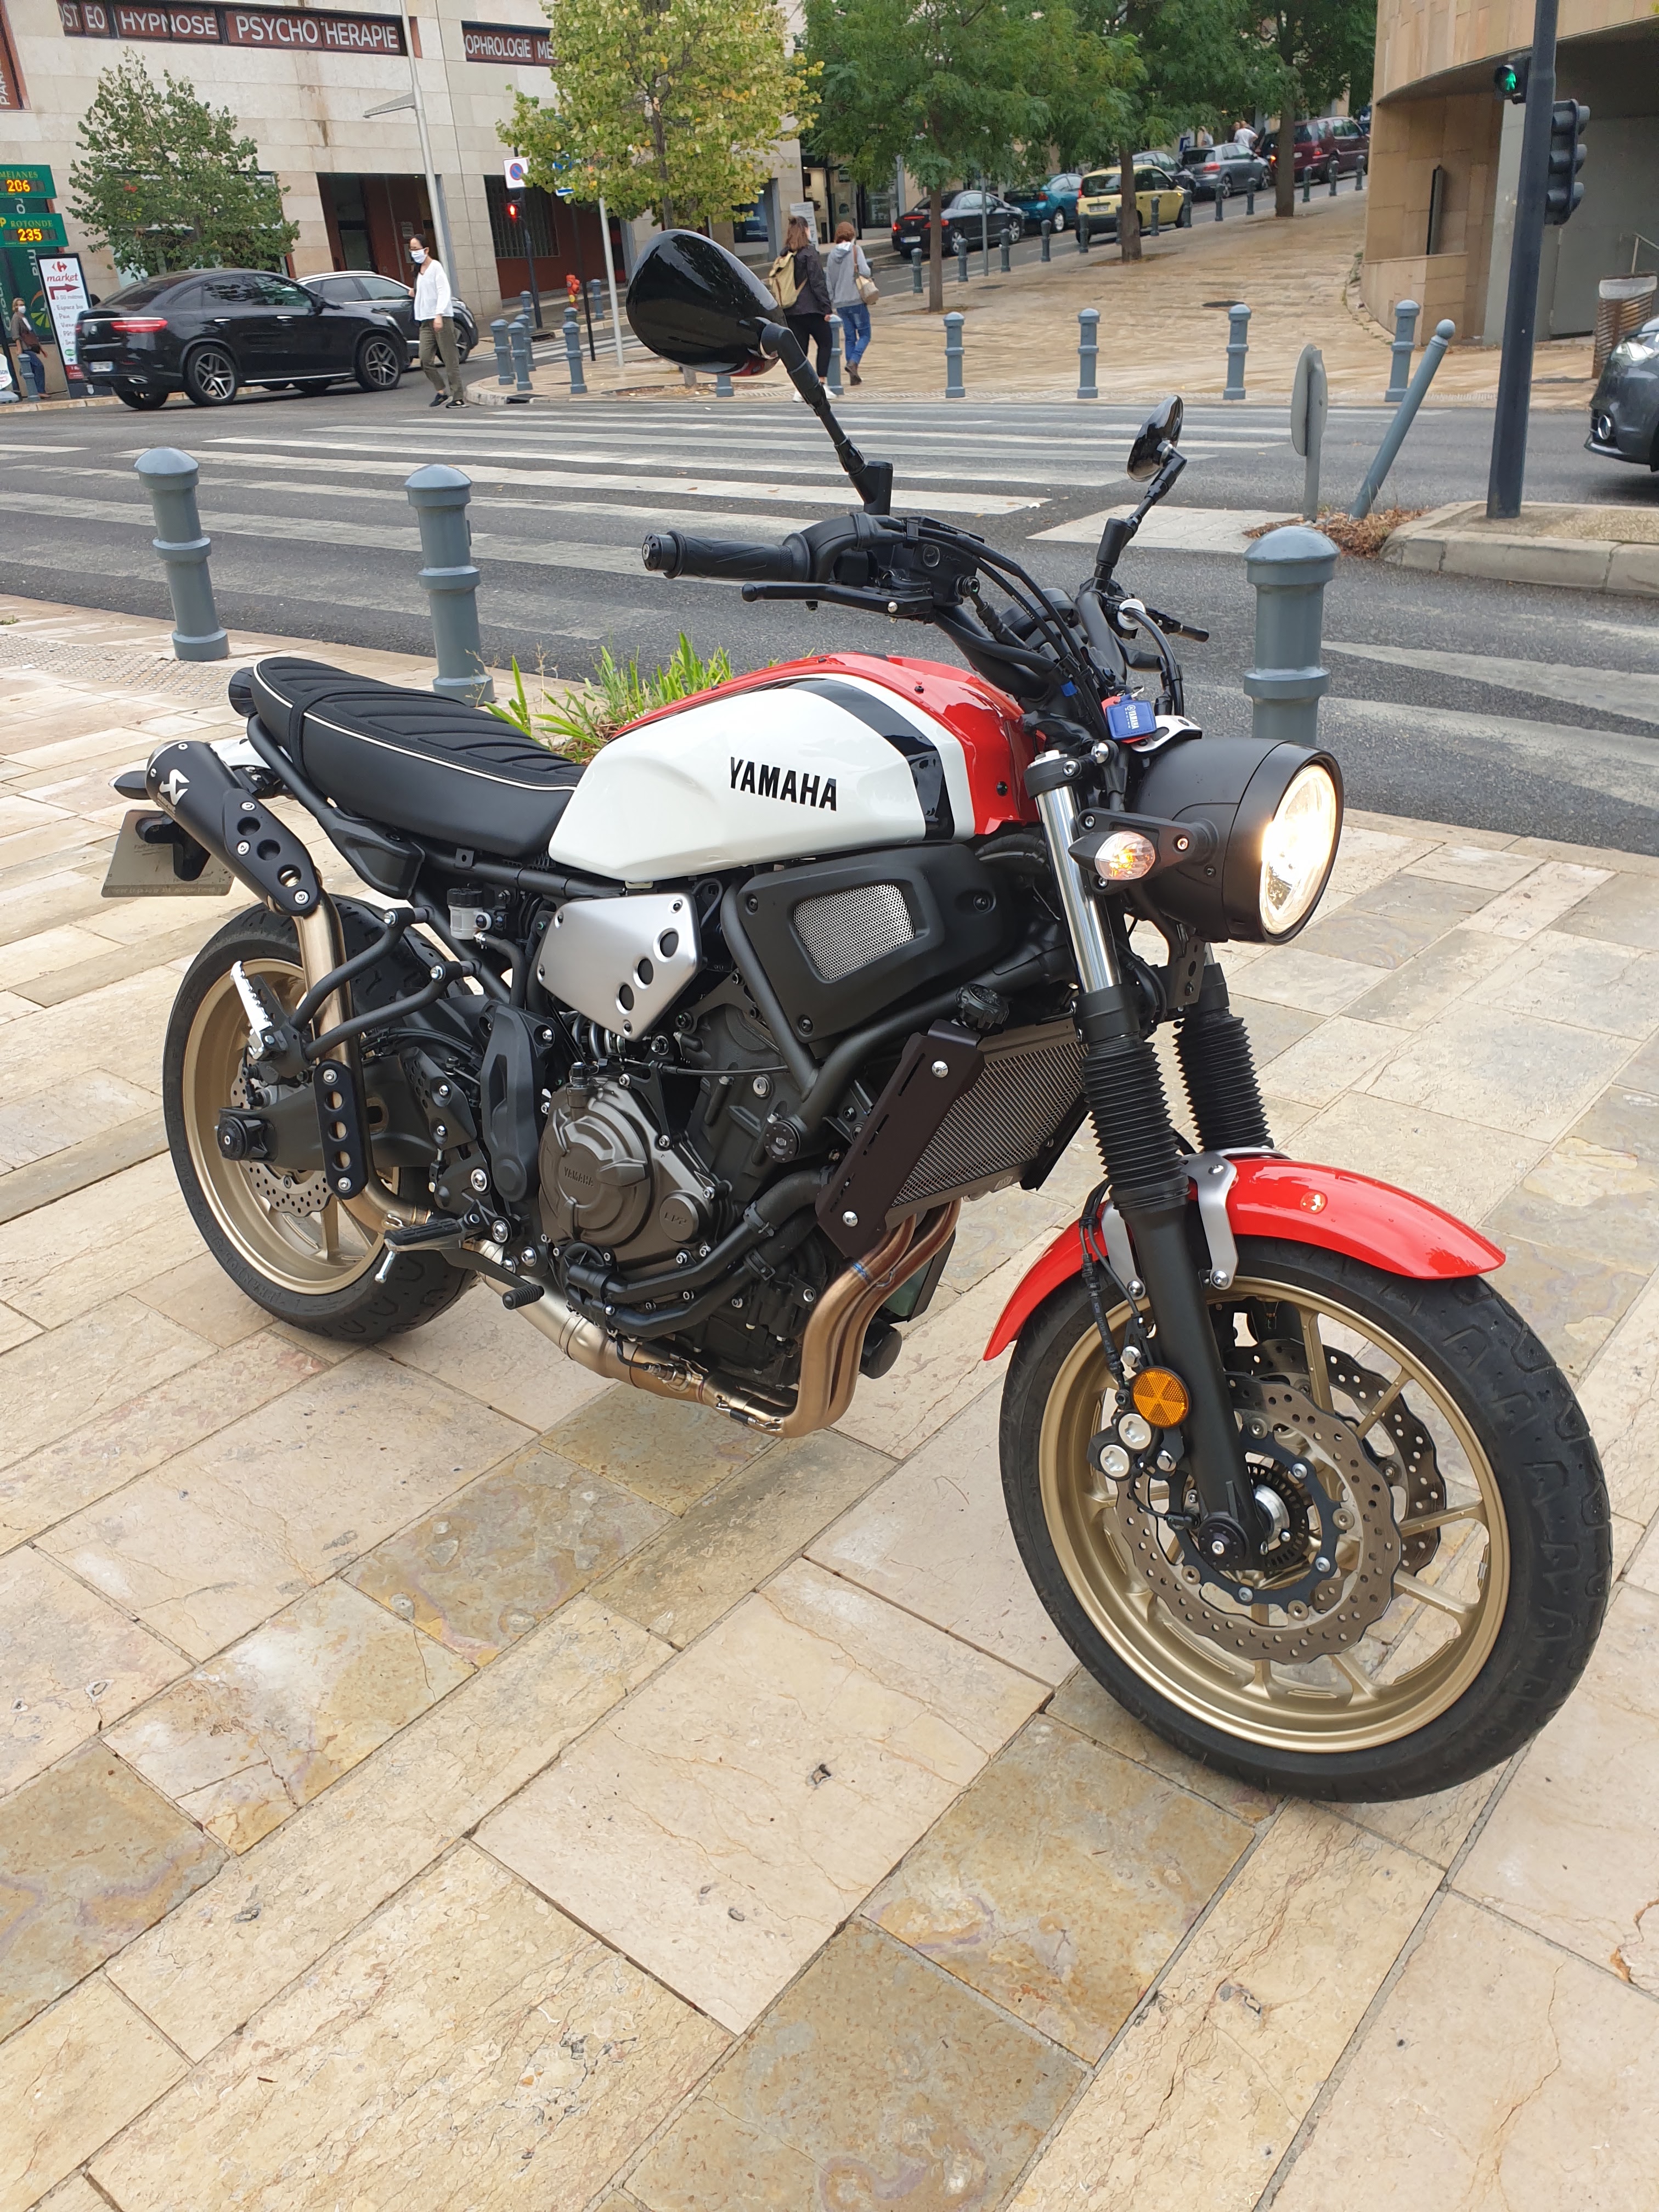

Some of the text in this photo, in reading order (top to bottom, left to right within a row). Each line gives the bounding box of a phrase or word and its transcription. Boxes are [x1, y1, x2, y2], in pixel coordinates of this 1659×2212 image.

[120, 11, 217, 35] HYPNOSE
[465, 34, 532, 58] OPHROLOGIE
[7, 179, 31, 193] 206
[18, 228, 42, 241] 235
[47, 273, 78, 282] market
[730, 757, 837, 811] YAMAHA
[564, 1166, 594, 1187] YAMAHA
